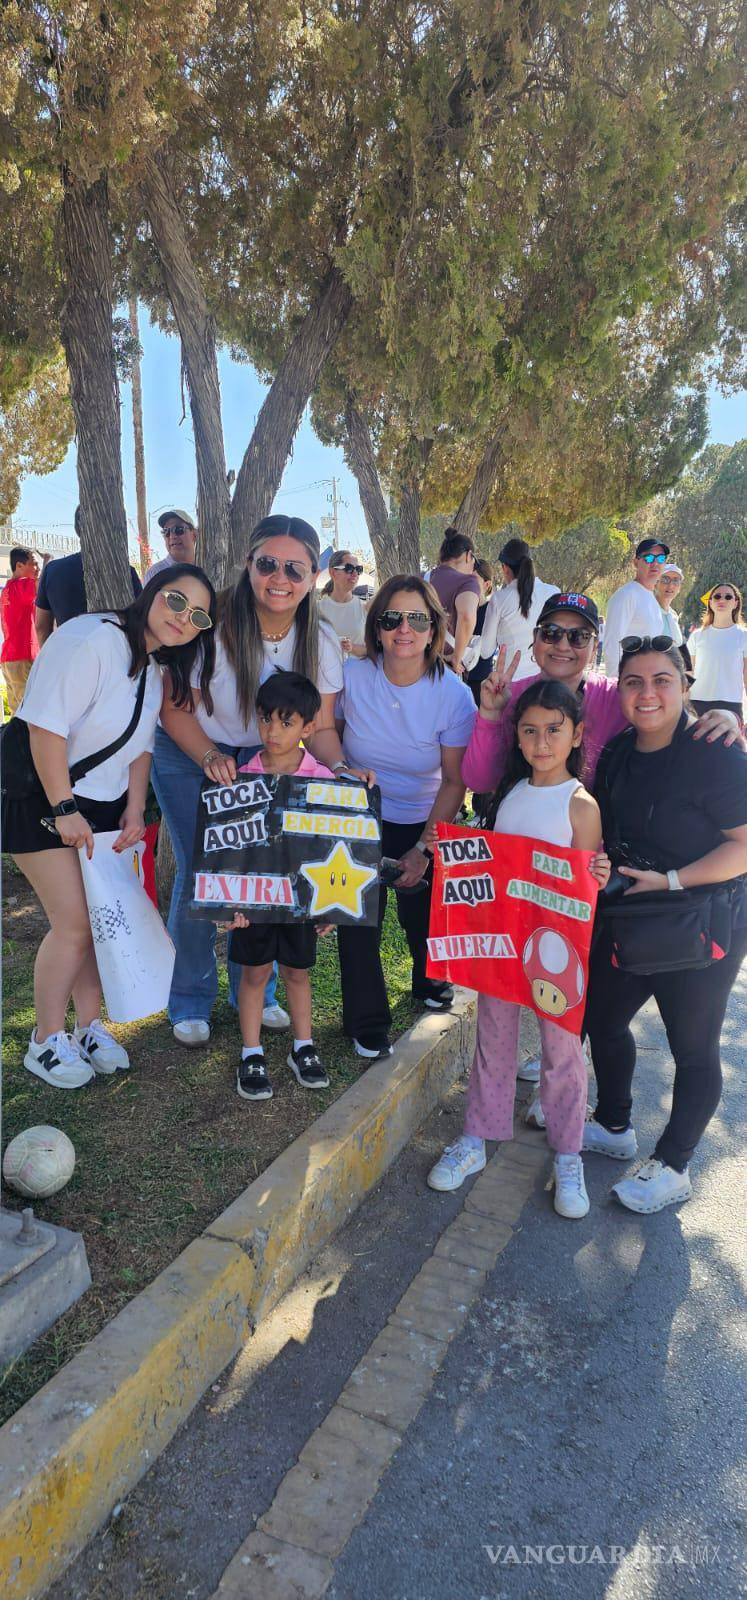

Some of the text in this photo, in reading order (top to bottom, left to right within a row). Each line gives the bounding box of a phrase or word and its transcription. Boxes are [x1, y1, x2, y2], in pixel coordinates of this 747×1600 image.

[204, 782, 270, 812] TOCA
[309, 784, 367, 808] PARA
[439, 839, 491, 863] TOCA
[533, 852, 571, 878] PARA
[198, 875, 293, 903] EXTRA
[444, 875, 494, 905] AQUÍ
[508, 881, 591, 919] AUMENTAR
[429, 936, 516, 959] FUERZA
